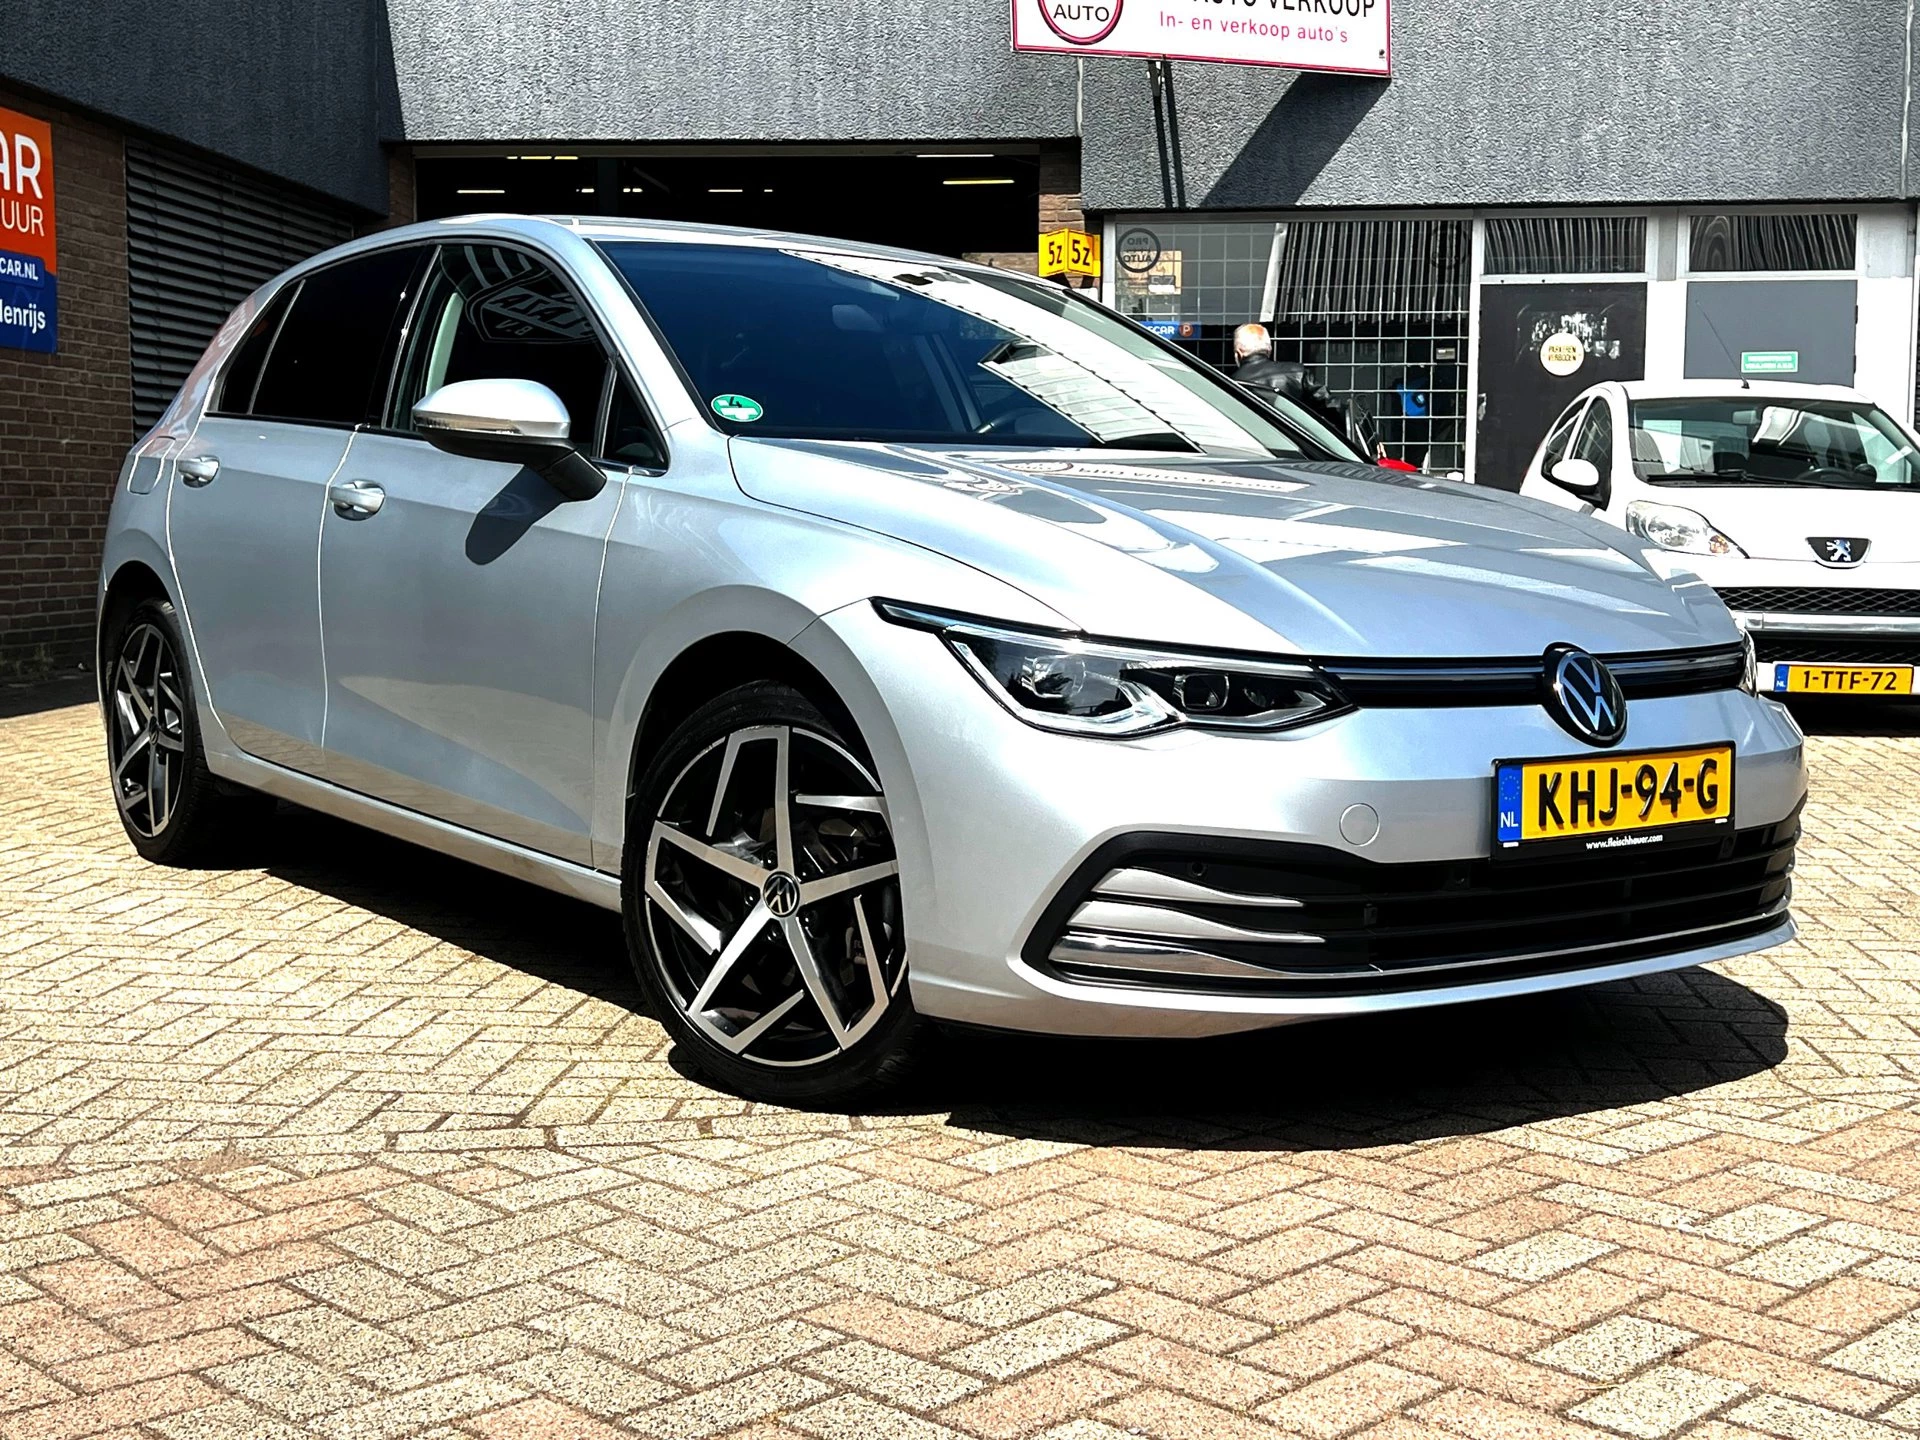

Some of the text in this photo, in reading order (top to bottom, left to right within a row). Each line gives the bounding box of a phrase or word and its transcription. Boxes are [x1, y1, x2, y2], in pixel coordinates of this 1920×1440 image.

[1053, 4, 1110, 22] AUTO
[1160, 11, 1348, 43] In- en verkoop auto's
[729, 396, 743, 408] 4
[1803, 670, 1897, 691] 1-TTF-72
[1538, 758, 1718, 827] KHJ-94-G
[1500, 811, 1519, 828] NL
[1586, 834, 1663, 850] www.fleischhauer.com
